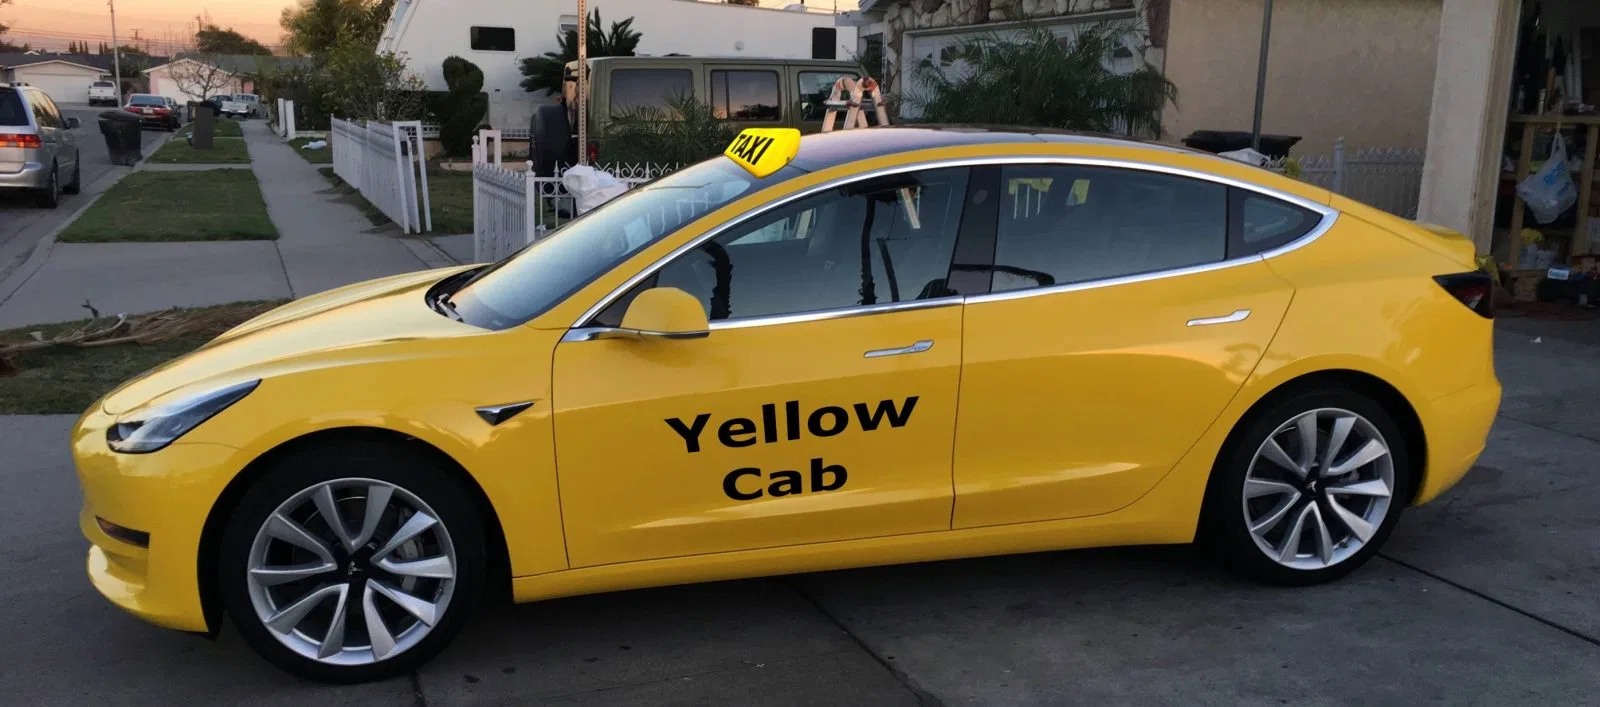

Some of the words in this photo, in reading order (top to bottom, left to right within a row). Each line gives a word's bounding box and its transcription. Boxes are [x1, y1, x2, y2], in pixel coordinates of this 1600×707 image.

[730, 134, 775, 166] TAXI
[664, 396, 920, 453] Yellow
[723, 457, 848, 500] Cab
